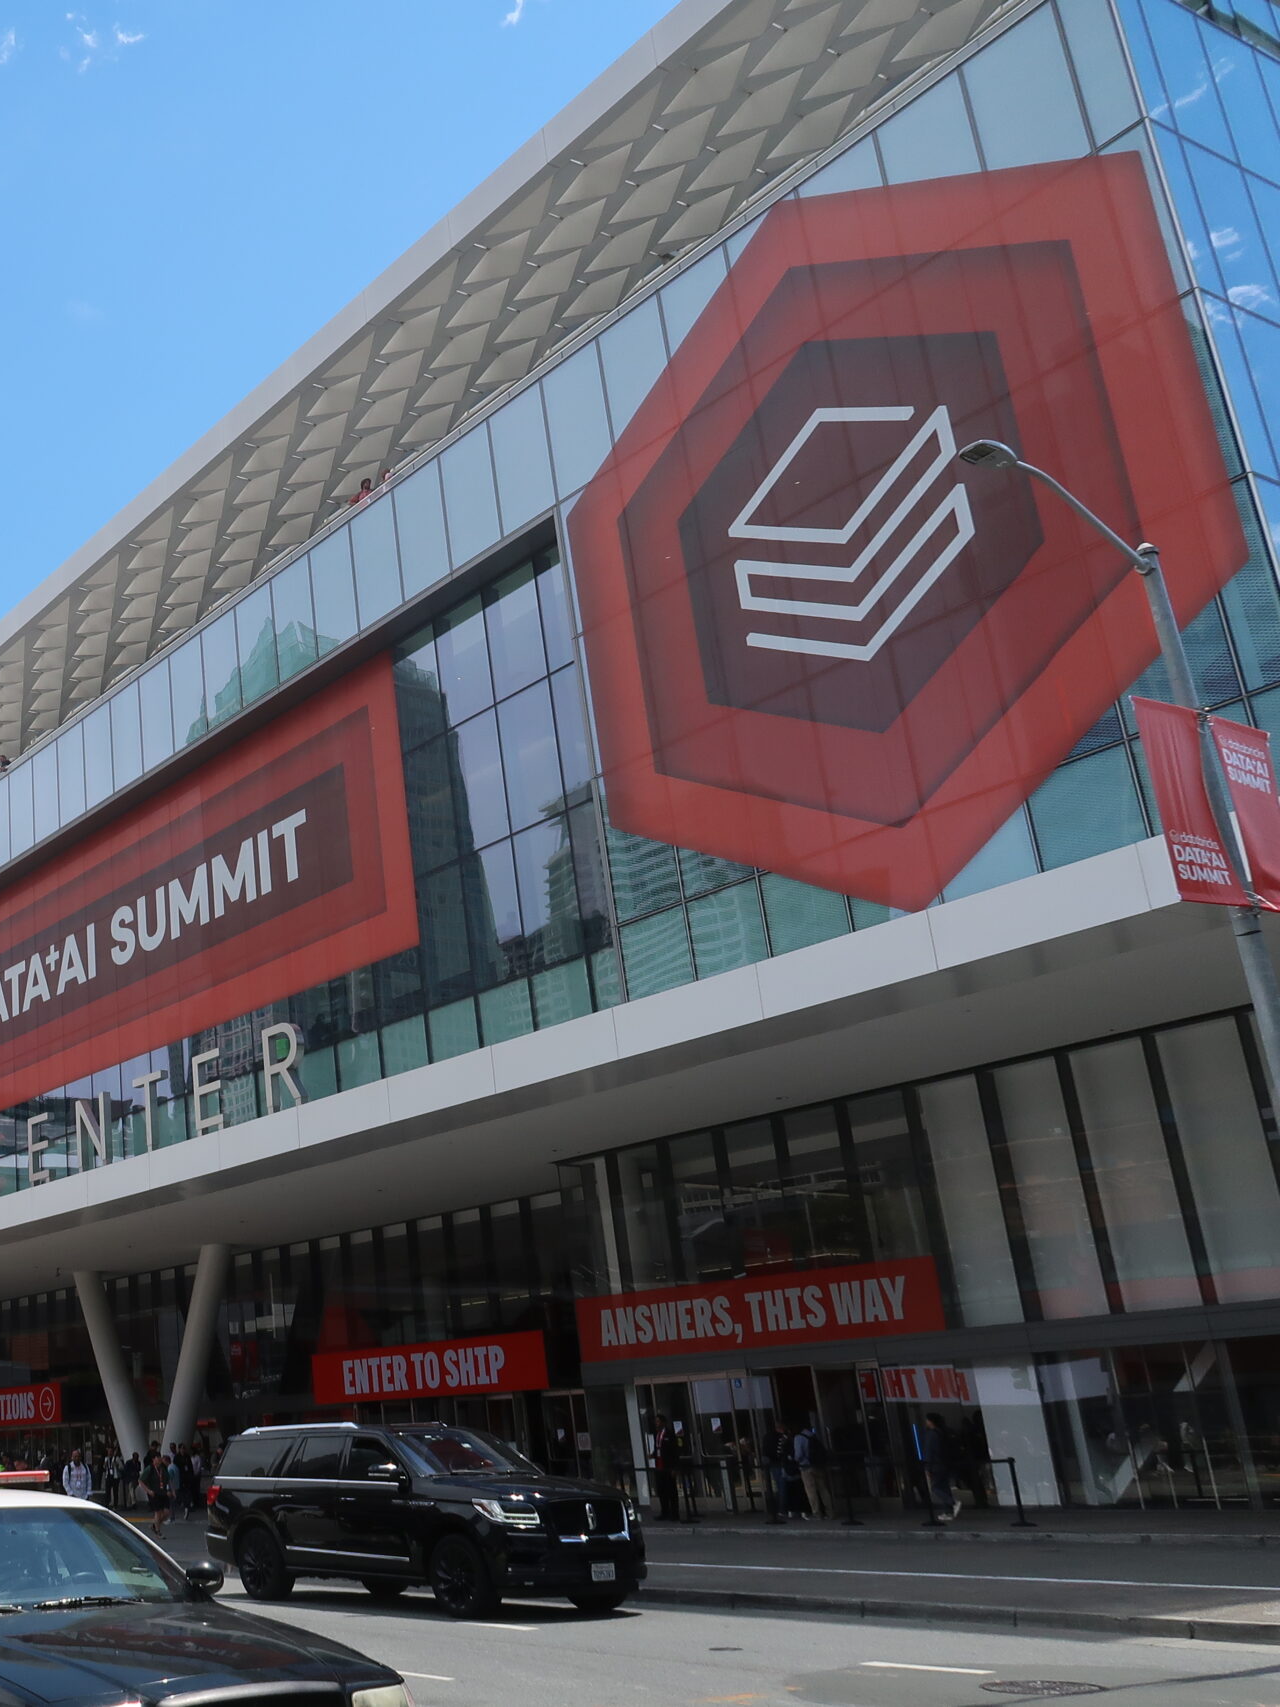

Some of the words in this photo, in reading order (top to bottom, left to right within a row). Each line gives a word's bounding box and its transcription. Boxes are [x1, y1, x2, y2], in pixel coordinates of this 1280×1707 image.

[1228, 768, 1271, 794] SUMMIT
[110, 808, 307, 967] SUMMIT
[1178, 866, 1232, 886] SUMMIT
[600, 1296, 744, 1347] ANSWERS,
[744, 1285, 826, 1333] THIS
[828, 1275, 907, 1325] WAY
[342, 1355, 408, 1396] ENTER
[410, 1351, 440, 1390] TO
[443, 1344, 505, 1387] SHIP
